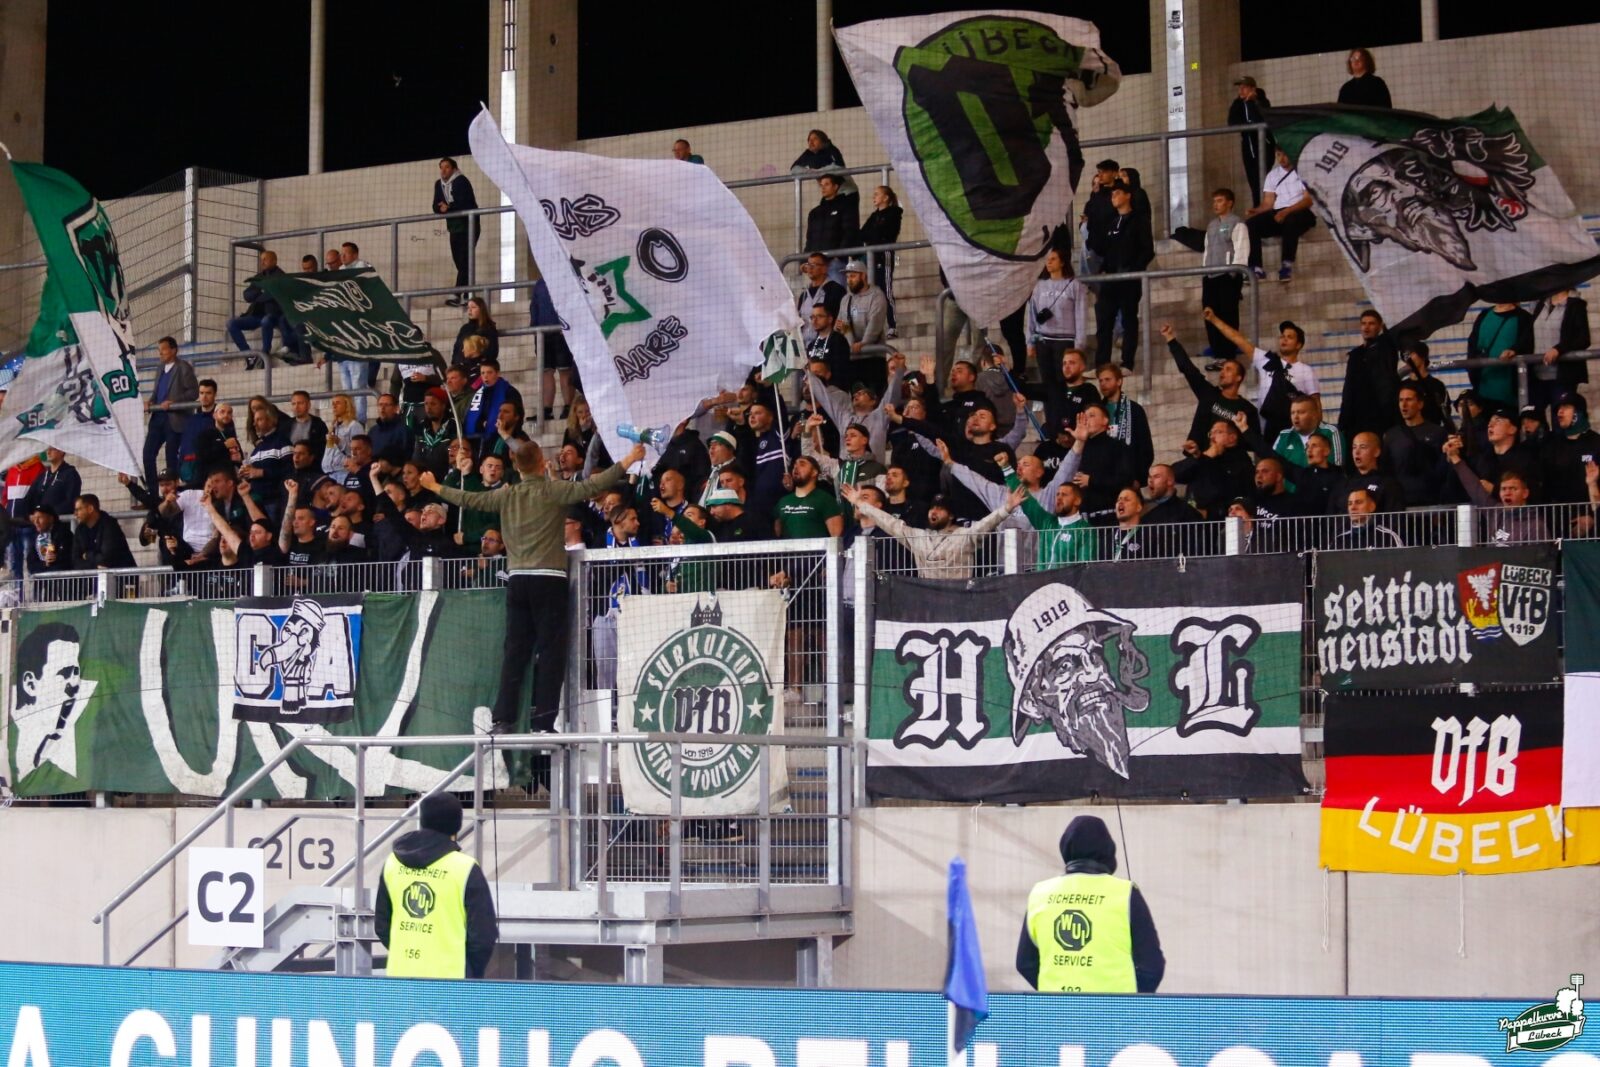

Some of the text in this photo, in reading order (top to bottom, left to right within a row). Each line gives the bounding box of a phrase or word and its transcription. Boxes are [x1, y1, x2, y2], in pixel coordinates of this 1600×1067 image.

[1315, 140, 1349, 174] 1919
[1503, 565, 1550, 586] LÜBECK
[1031, 598, 1071, 634] 1919
[1501, 584, 1548, 625] VfB
[1509, 623, 1536, 637] 1919
[647, 631, 761, 692] SUBKULTUR
[697, 746, 714, 758] 1919
[1430, 713, 1522, 806] VfB
[690, 753, 742, 792] YOUTH
[1357, 796, 1574, 865] LÜBECK
[248, 837, 335, 870] 2 C3
[398, 866, 449, 880] SICHERHEIT
[197, 871, 256, 924] C2
[1047, 893, 1106, 906] SICHERHEIT
[400, 921, 434, 934] SERVICE
[404, 948, 421, 960] 156
[1053, 955, 1094, 967] SERVICE
